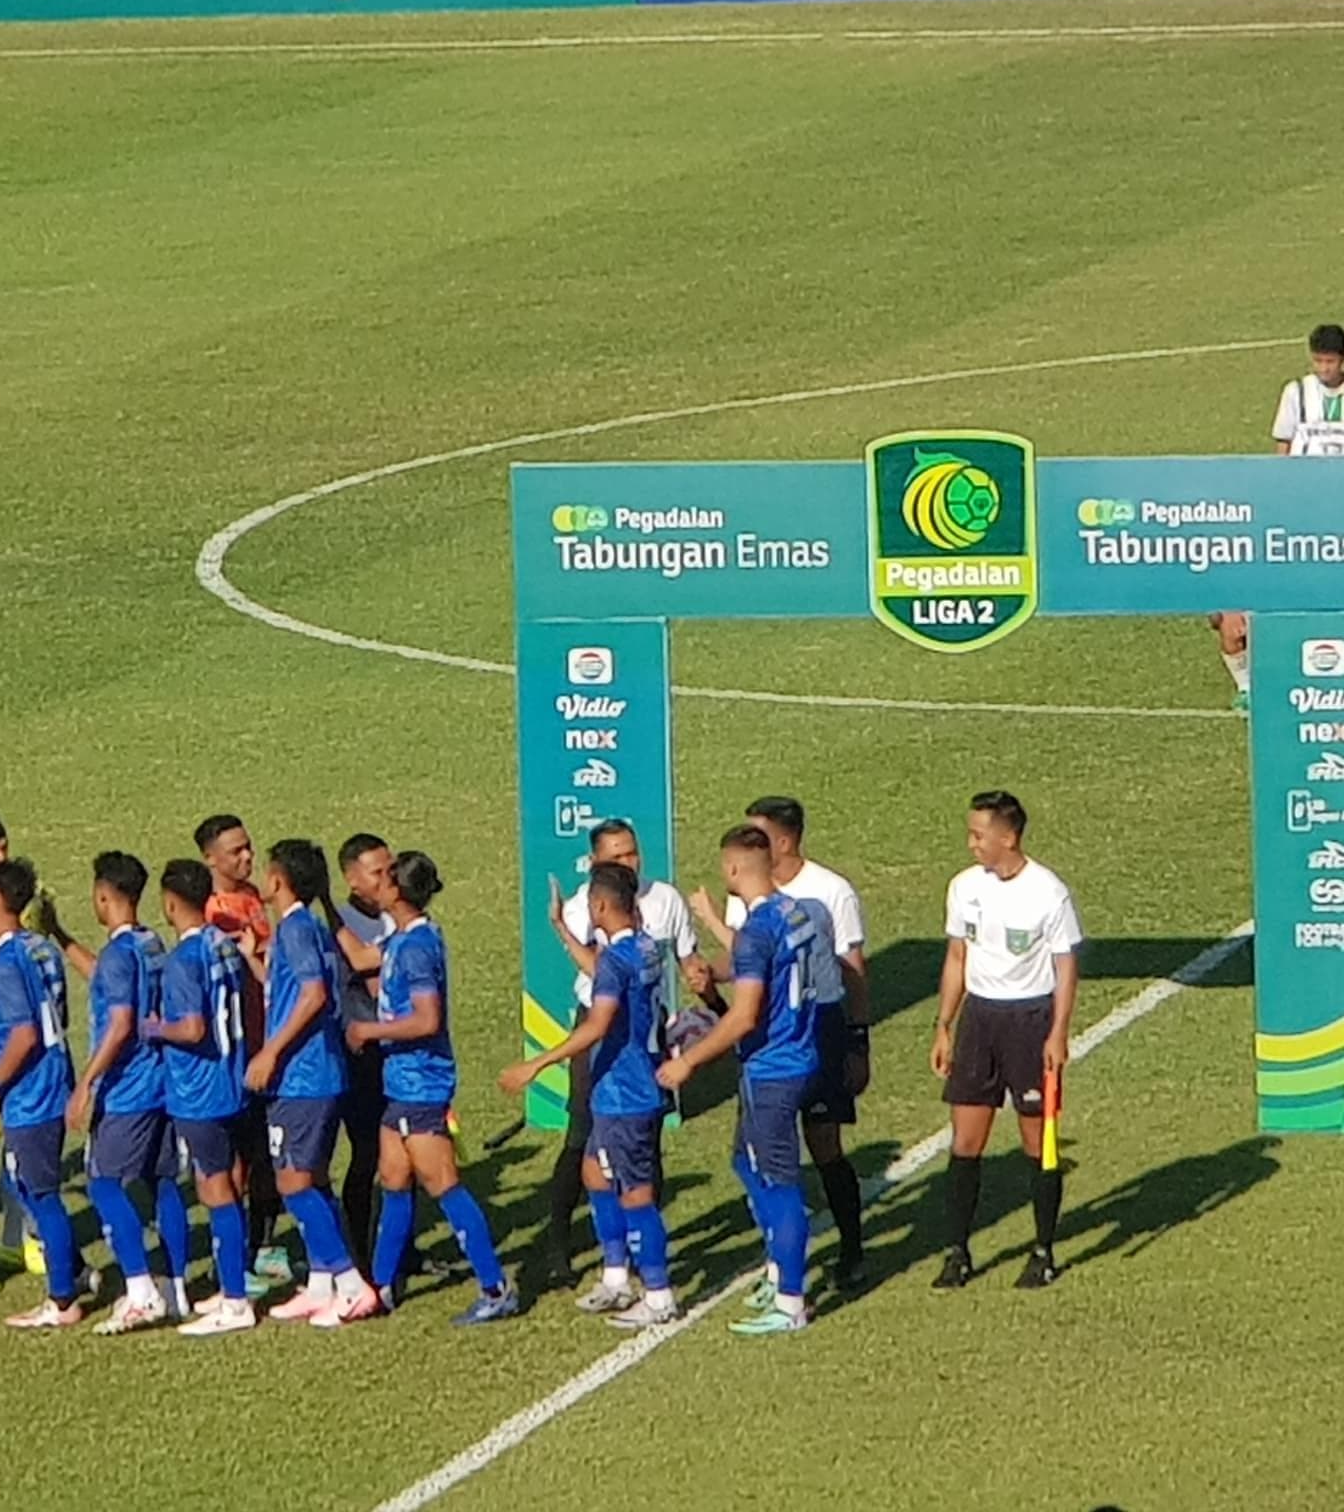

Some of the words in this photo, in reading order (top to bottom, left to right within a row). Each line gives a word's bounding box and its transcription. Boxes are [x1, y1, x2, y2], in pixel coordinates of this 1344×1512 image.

[615, 507, 723, 533] Pegadaian
[1141, 500, 1252, 527] Pegadaian
[553, 535, 725, 577] Tabungan
[736, 533, 830, 569] Emas
[1078, 529, 1253, 572] Tabungan
[885, 561, 1021, 592] Pegadaian
[912, 599, 975, 625] LIGA
[977, 599, 996, 625] 2
[556, 693, 627, 720] Vidio
[565, 729, 618, 749] nex
